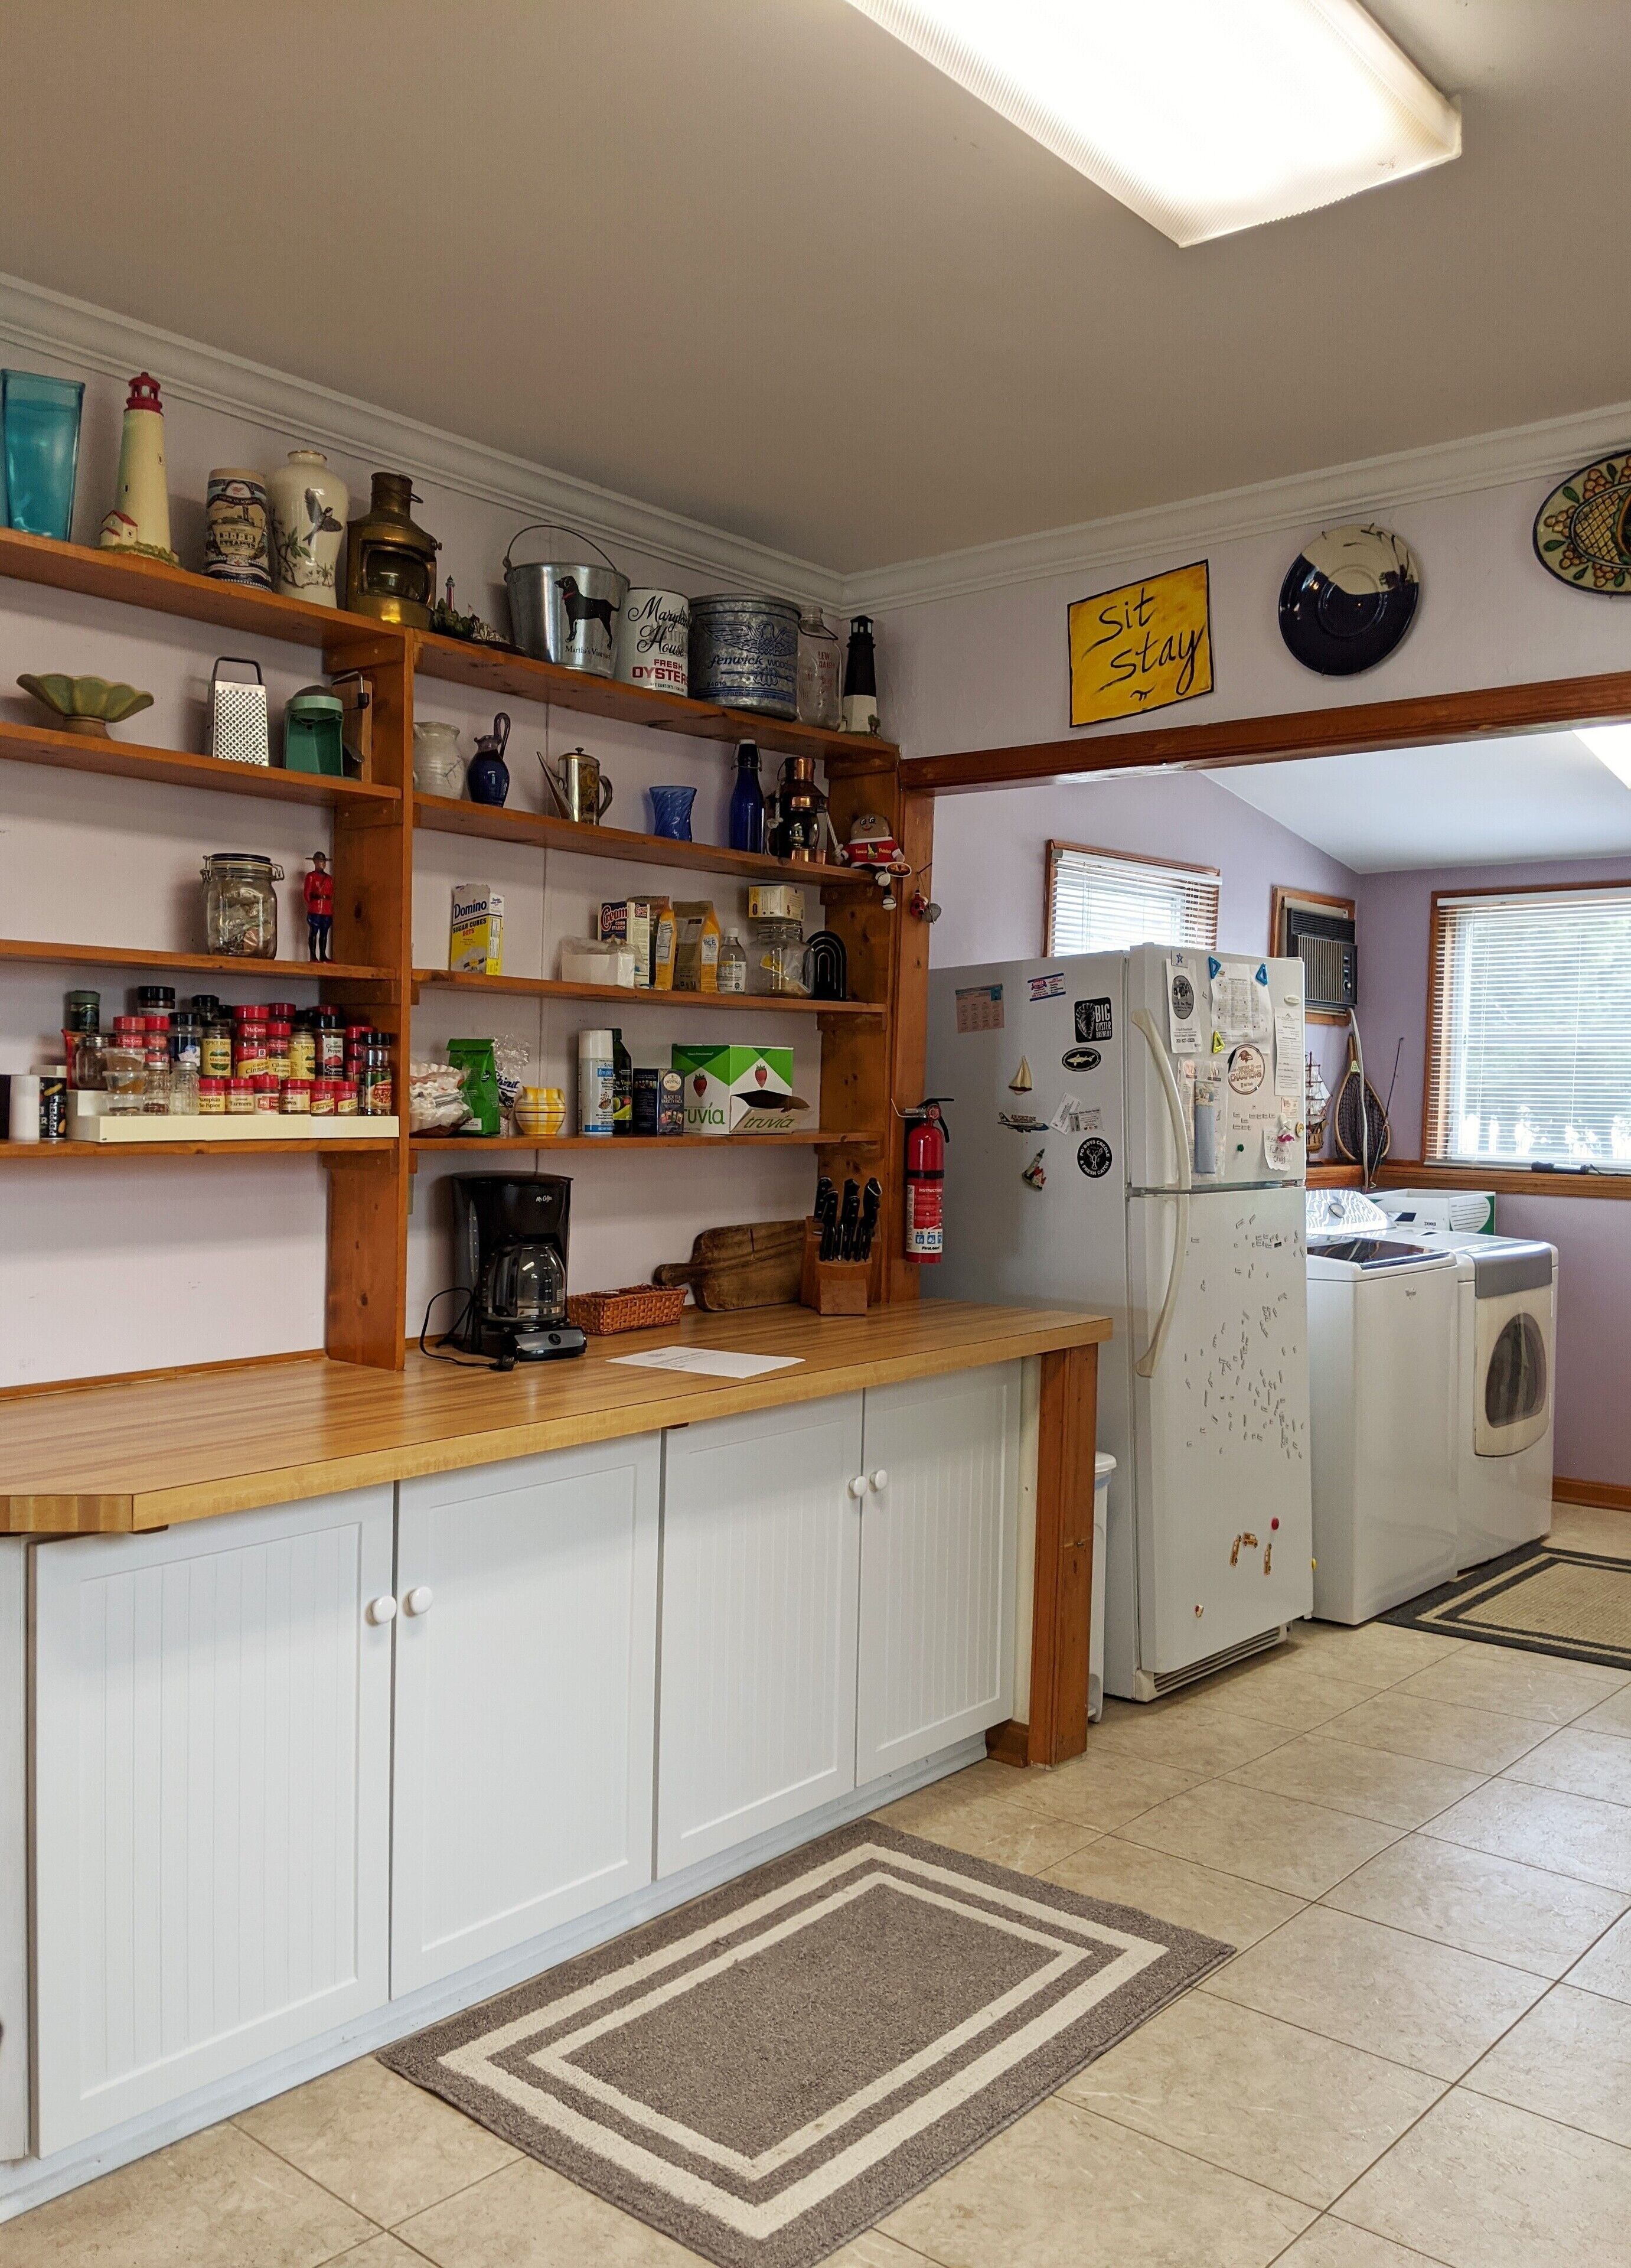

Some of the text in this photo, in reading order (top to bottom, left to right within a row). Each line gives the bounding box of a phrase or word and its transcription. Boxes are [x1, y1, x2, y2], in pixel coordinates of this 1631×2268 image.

[628, 595, 689, 633] Marylan
[1081, 587, 1157, 661] Sit
[637, 624, 684, 657] House
[565, 646, 591, 654] Martha's
[654, 659, 683, 670] FRESH
[707, 654, 764, 669] fenwick
[454, 900, 487, 919] Domino
[601, 905, 628, 931] Cream
[453, 918, 487, 933] SUGAR CUBES
[1095, 1003, 1110, 1022] BIG
[1095, 1021, 1111, 1031] OYSTER
[49, 1102, 57, 1136] PEPPER
[1097, 1140, 1110, 1157] CREOLE
[1082, 1165, 1097, 1175] FRESH
[1097, 1161, 1110, 1175] CATCH
